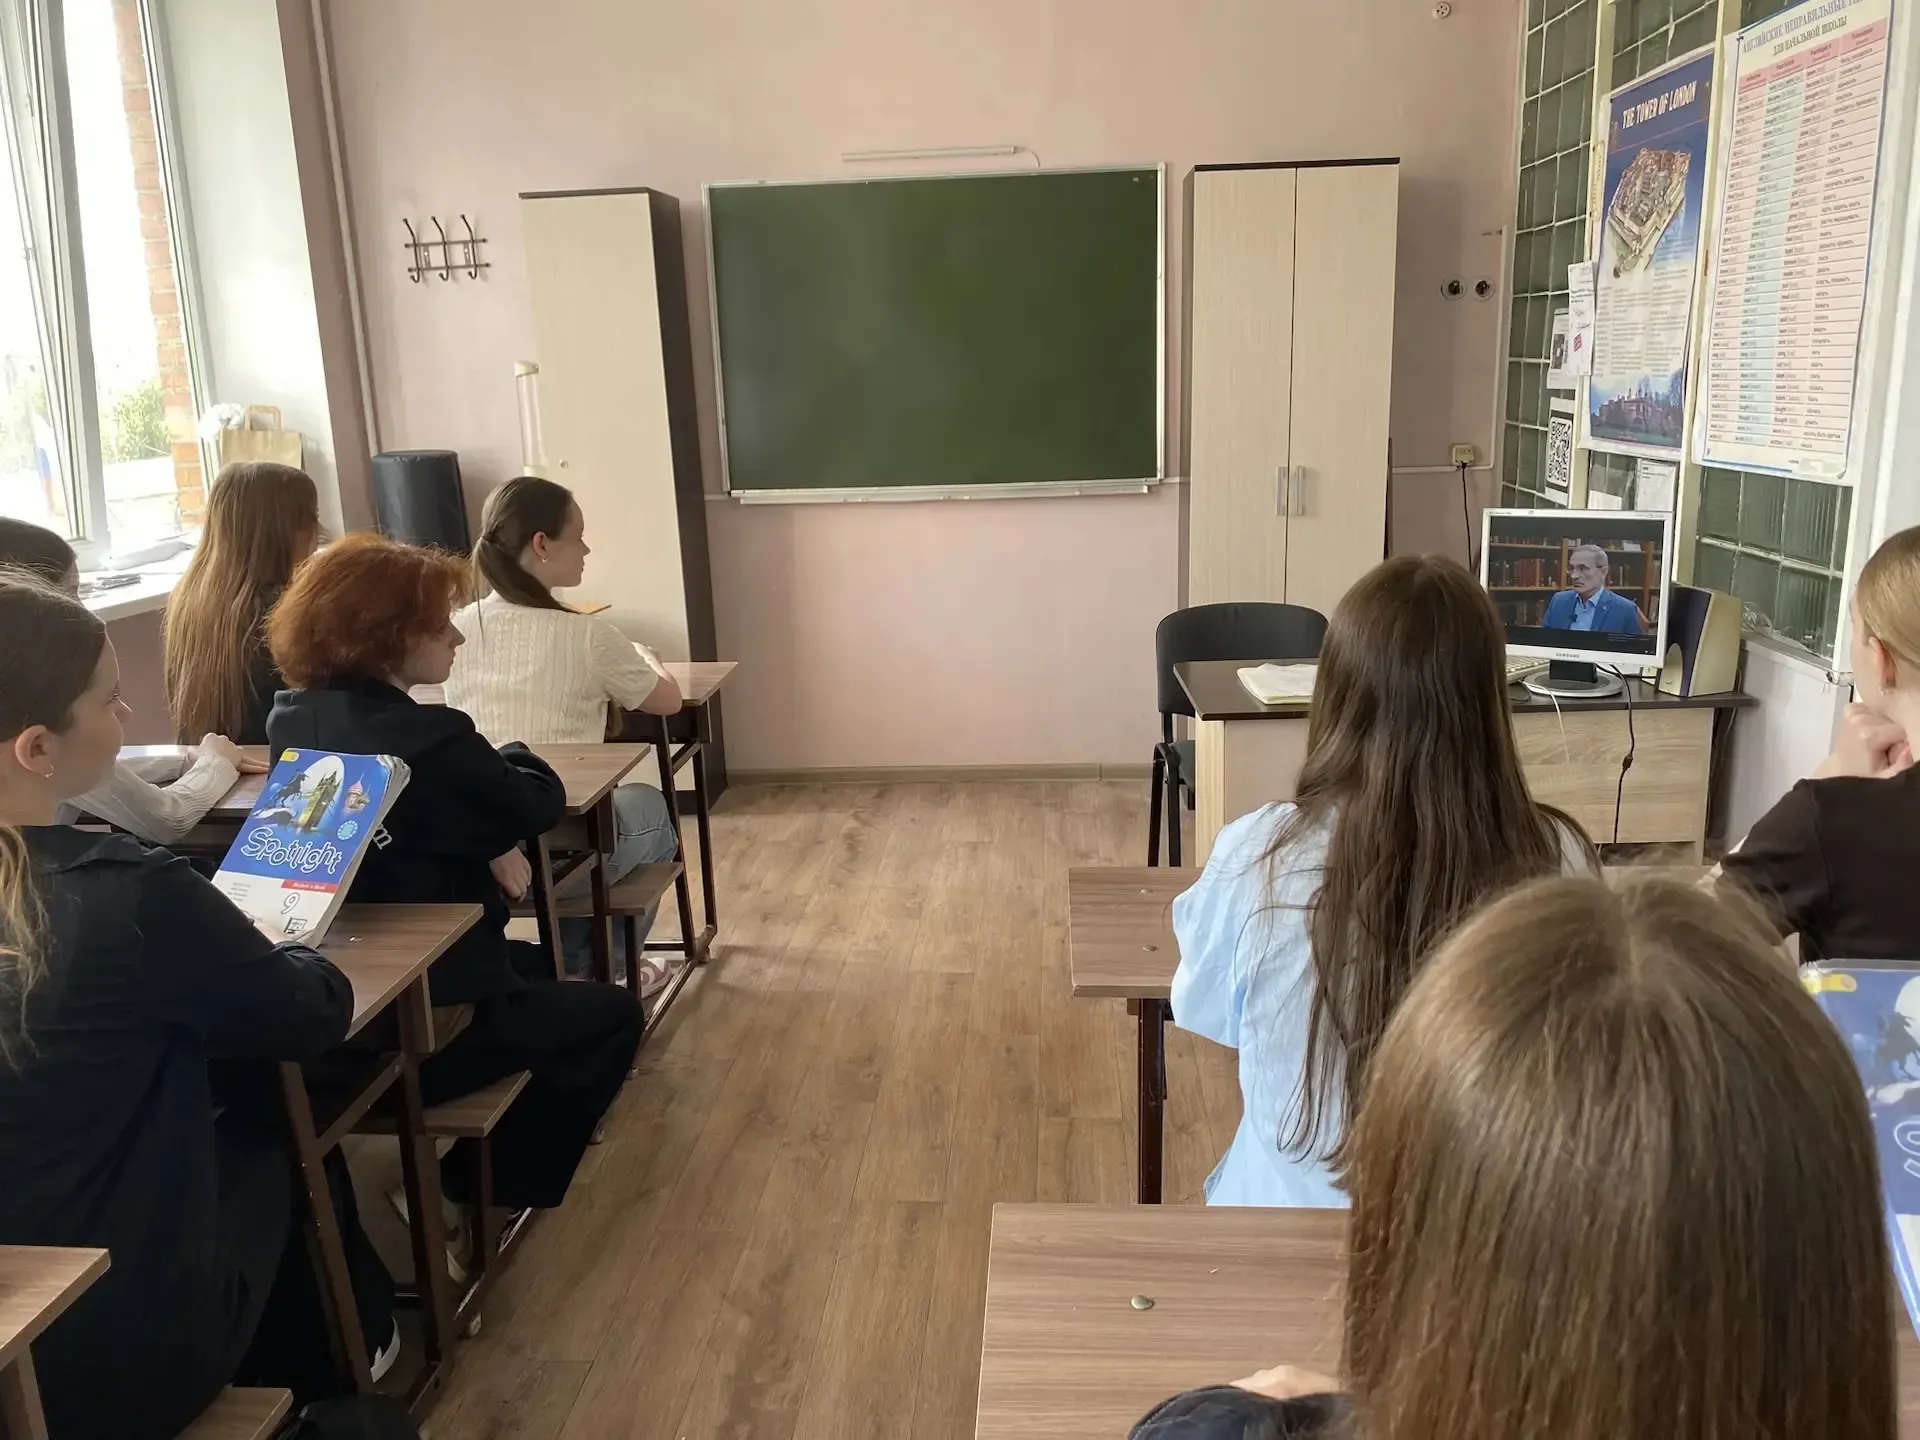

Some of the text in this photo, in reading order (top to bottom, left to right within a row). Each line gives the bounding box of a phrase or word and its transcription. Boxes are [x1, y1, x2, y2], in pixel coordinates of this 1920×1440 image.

[1743, 0, 1847, 53] АНГЛИЙСКИЕ НЕПРАВИЛЬНЫЕ
[1785, 26, 1819, 51] НАЧАЛЬНОЙ
[1822, 15, 1847, 34] ШКОЛЫ
[1622, 80, 1697, 129] THE TOWER OF LONDON
[240, 826, 342, 875] Spotlight
[281, 892, 300, 914] 9
